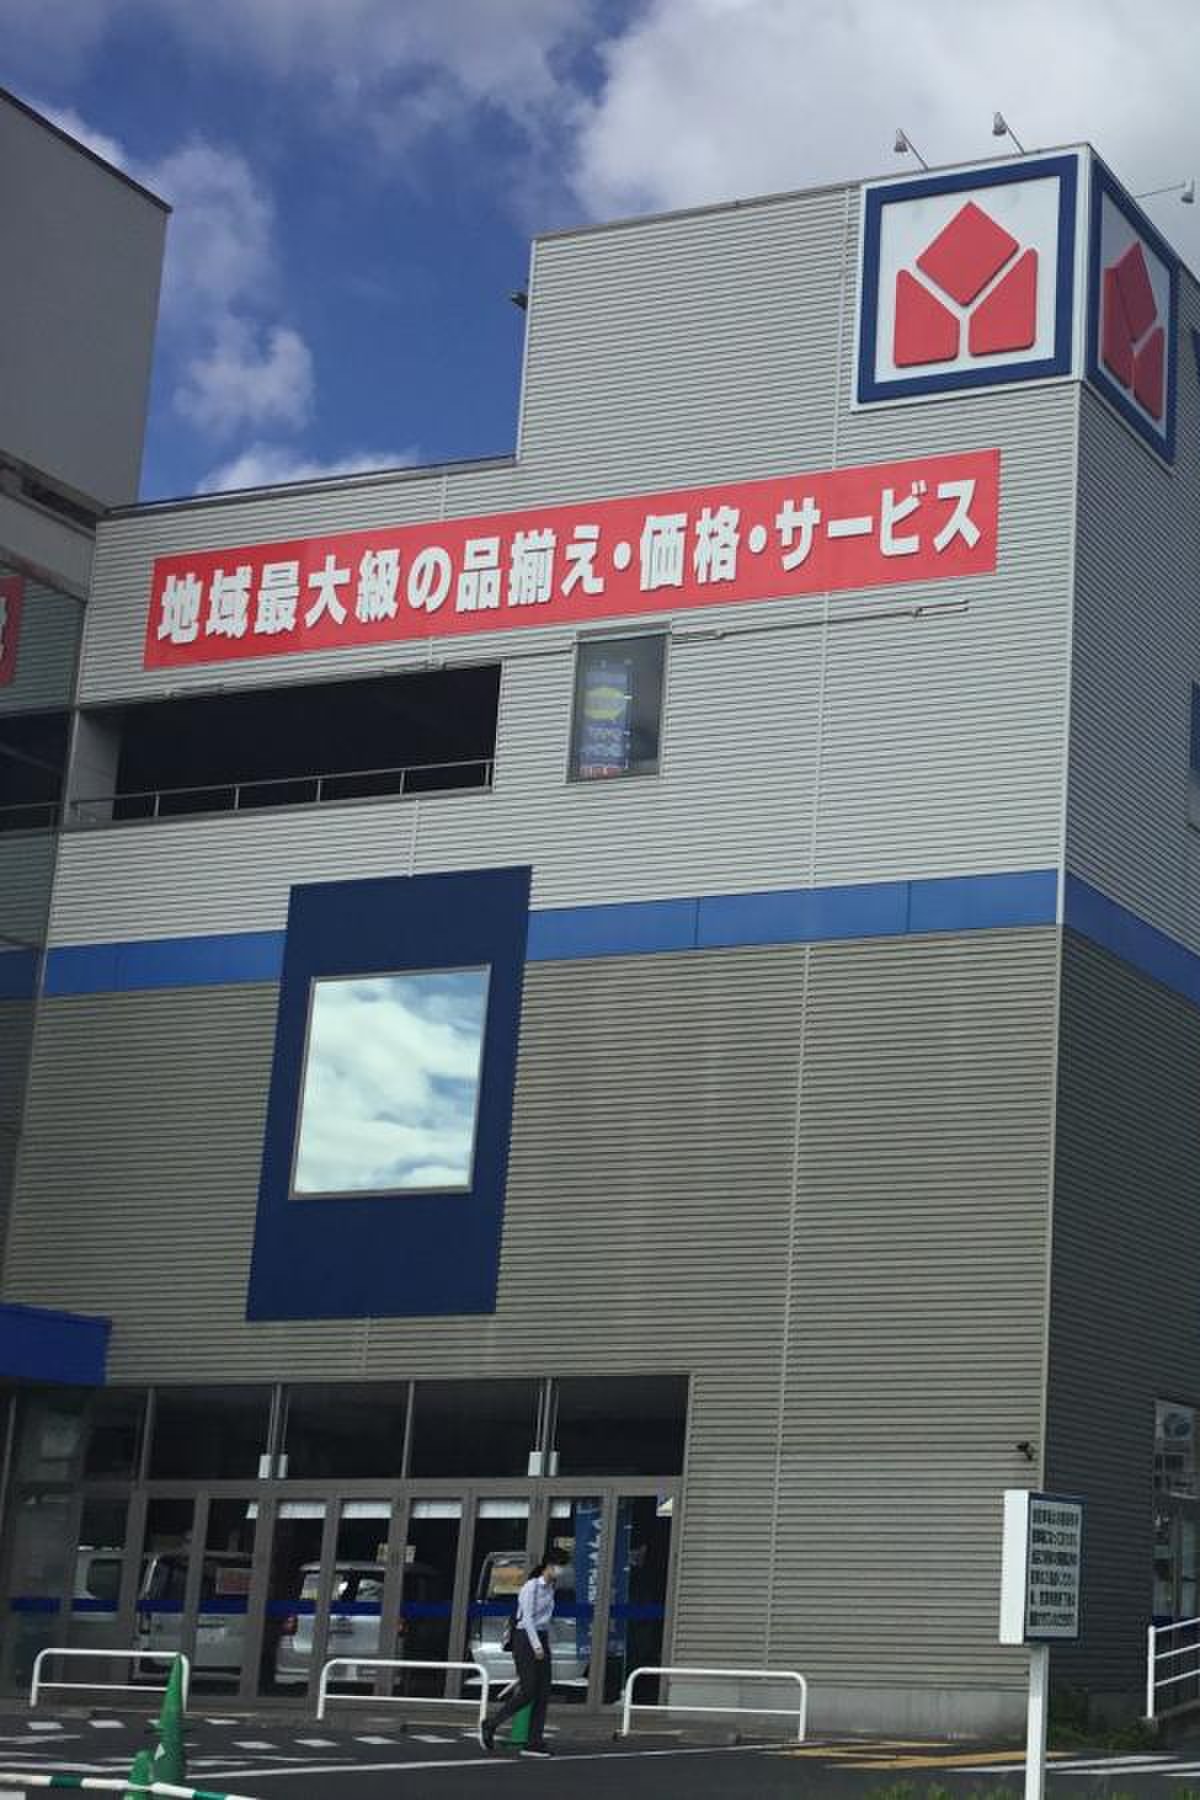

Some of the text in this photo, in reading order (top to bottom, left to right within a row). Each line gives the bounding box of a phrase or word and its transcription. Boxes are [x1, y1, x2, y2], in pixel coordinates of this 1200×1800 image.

[157, 478, 981, 645] 地域最大級の品揃え・価格・サービス
